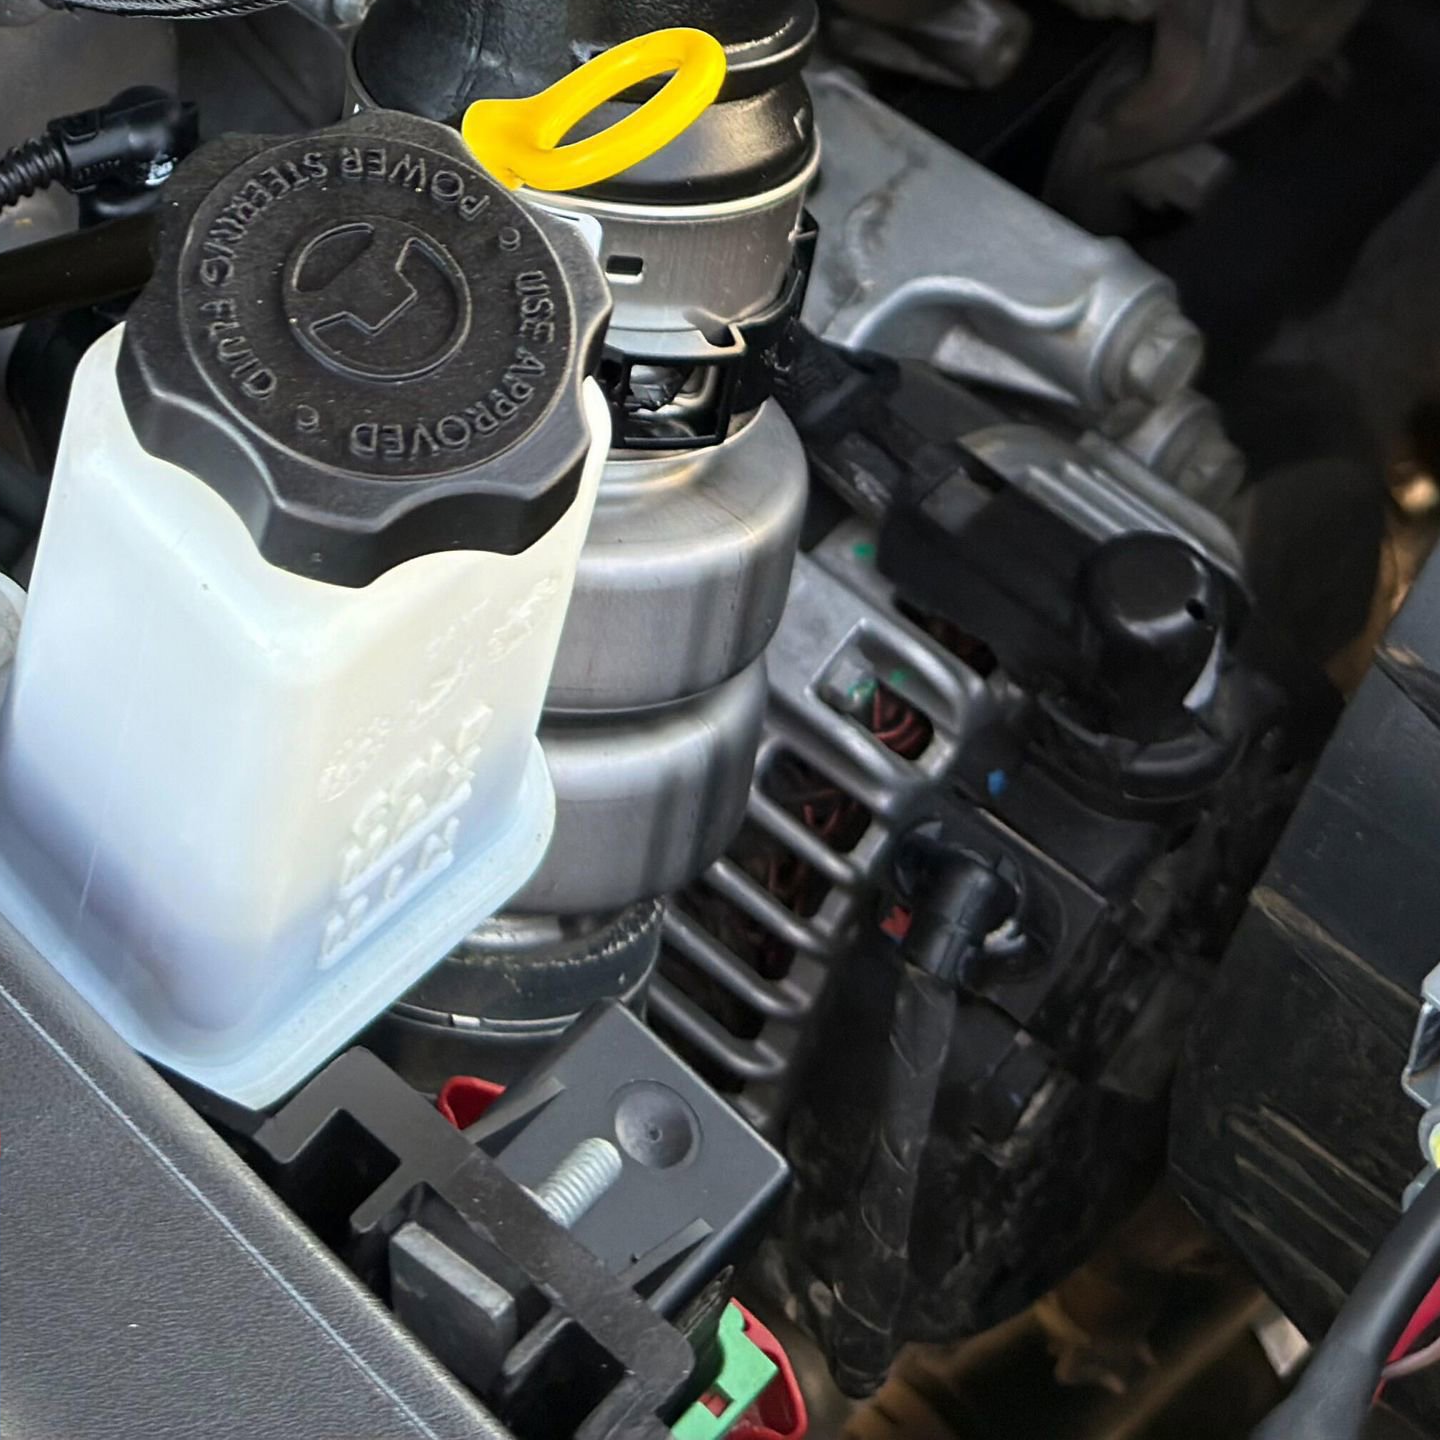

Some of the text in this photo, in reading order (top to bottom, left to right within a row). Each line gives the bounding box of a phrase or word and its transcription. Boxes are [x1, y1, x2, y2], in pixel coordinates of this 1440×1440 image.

[199, 146, 491, 400] POWER STEERING FLUID
[514, 269, 556, 344] USE
[349, 347, 547, 460] APPROVED
